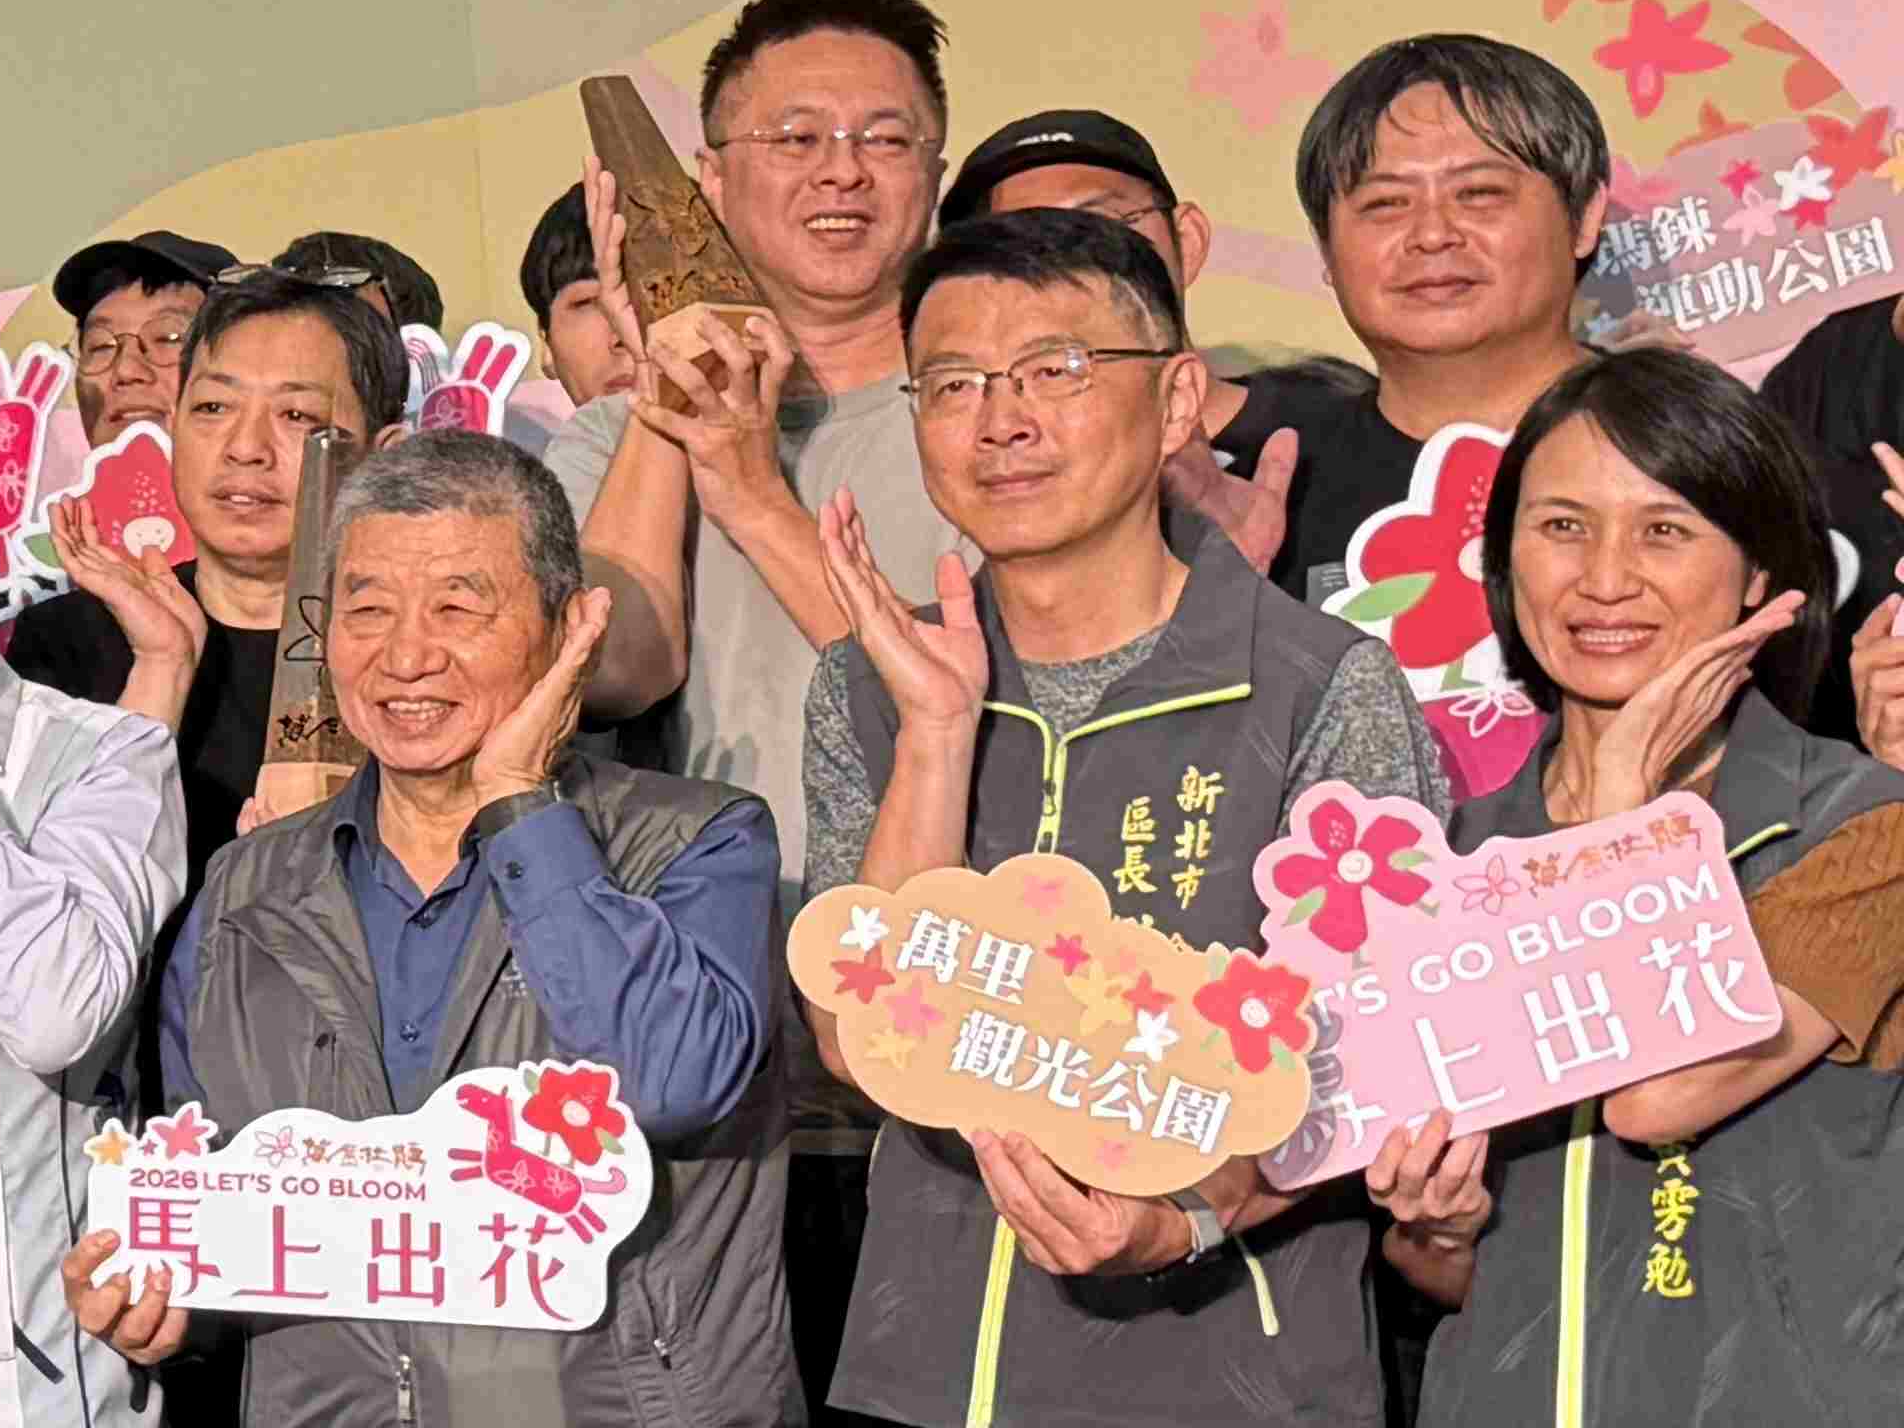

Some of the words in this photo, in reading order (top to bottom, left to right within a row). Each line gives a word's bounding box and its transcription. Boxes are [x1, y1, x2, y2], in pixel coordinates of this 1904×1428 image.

[1637, 217, 1894, 332] 運動公園
[1113, 796, 1159, 893] 區長
[1171, 765, 1224, 910] 新北市
[897, 908, 1034, 1005] 萬里
[1410, 942, 1493, 993] GO
[1507, 862, 1722, 965] BLOOM
[949, 1010, 1232, 1154] 觀光公園
[129, 1168, 198, 1190] 2026
[203, 1173, 272, 1194] LET'S
[281, 1177, 320, 1196] GO
[329, 1179, 427, 1202] BLOOM
[125, 1196, 576, 1323] 馬上出花
